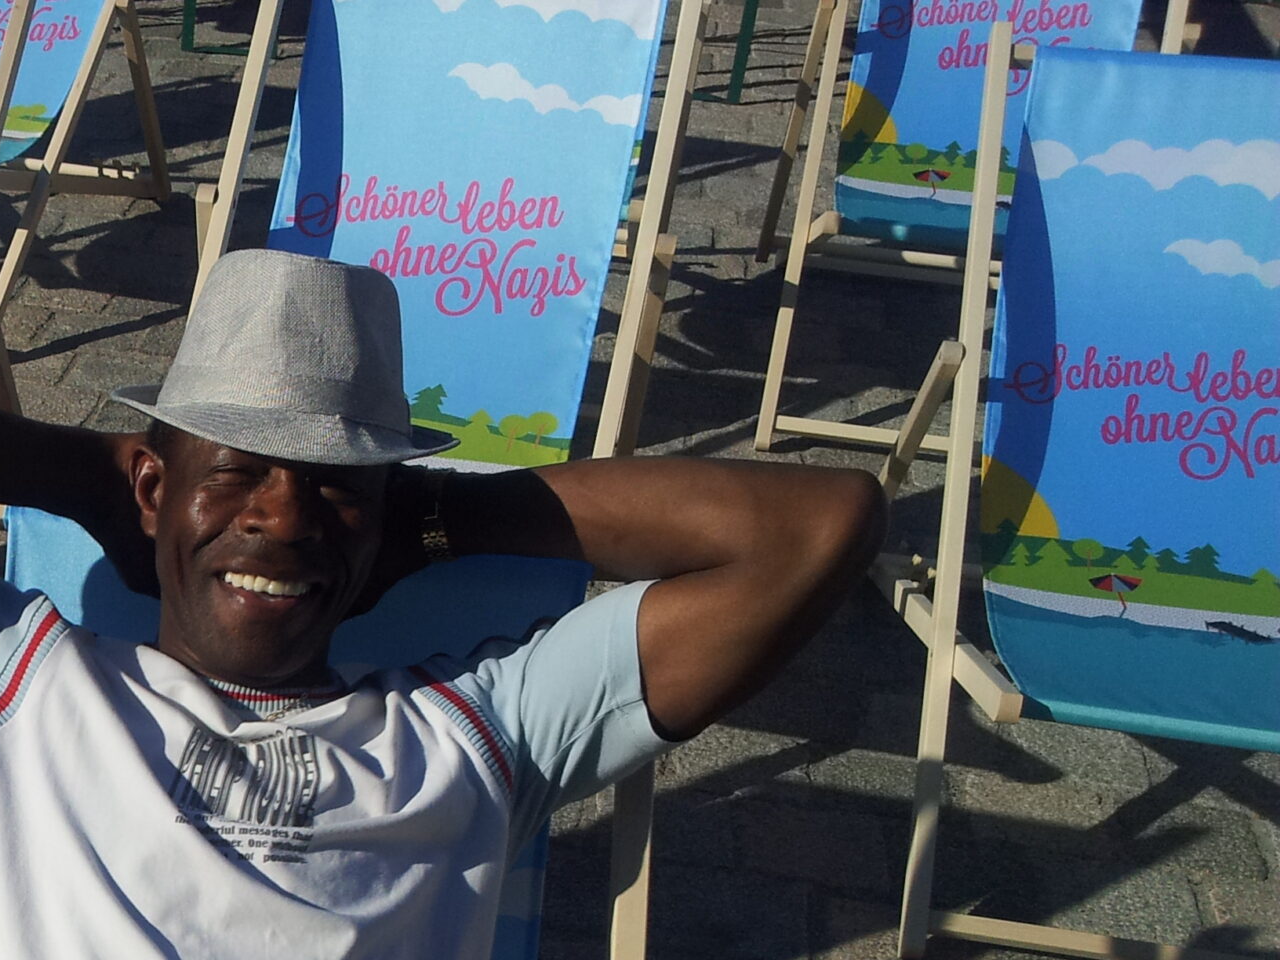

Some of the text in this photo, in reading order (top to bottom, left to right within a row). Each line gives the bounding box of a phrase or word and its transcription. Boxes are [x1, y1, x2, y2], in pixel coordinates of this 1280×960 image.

[1006, 0, 1092, 35] leben
[937, 28, 992, 70] ohn
[285, 173, 564, 237] Schöner leben
[370, 225, 586, 317] ohne Nazis
[1003, 343, 1190, 405] Schöner
[1100, 394, 1202, 445] ohne
